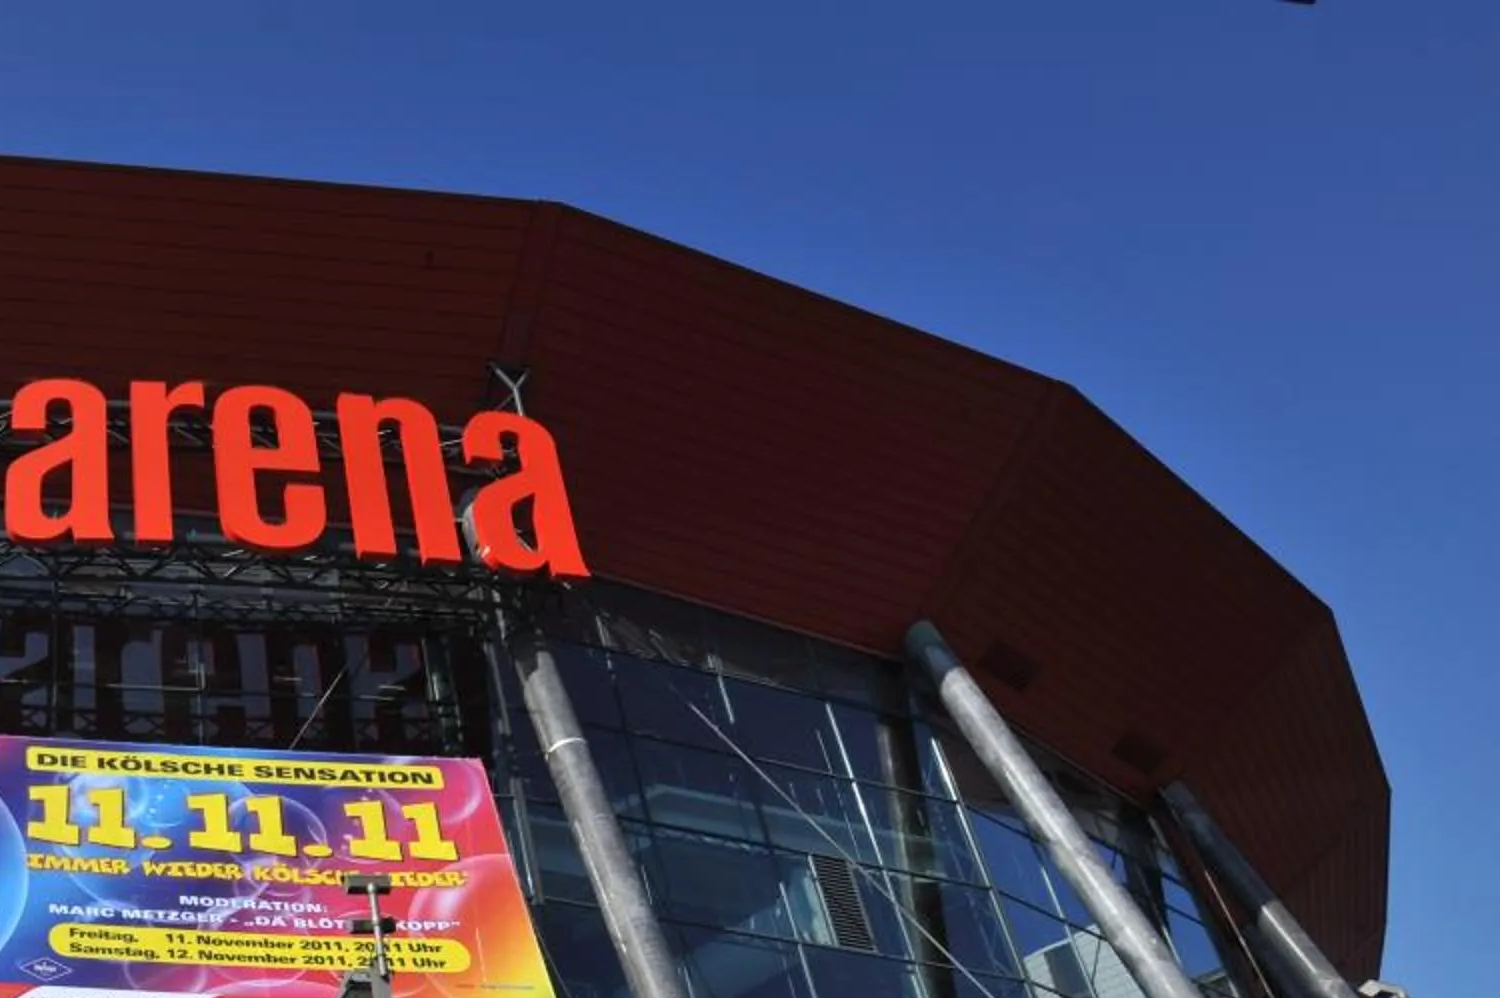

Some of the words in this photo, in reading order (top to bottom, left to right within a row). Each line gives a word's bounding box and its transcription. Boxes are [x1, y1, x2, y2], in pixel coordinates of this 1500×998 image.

[4, 378, 592, 578] arena
[36, 753, 87, 768] DIE
[97, 755, 245, 777] KÖLSCHE
[253, 765, 435, 785] SENSATION
[26, 853, 131, 875] IMMER
[142, 859, 245, 880] WIEDER
[253, 862, 360, 886] KÖLSC
[376, 871, 467, 888] IEDER
[49, 903, 116, 919] MARC
[121, 908, 224, 924] METZGER
[179, 895, 328, 914] MODERATION:
[165, 933, 193, 945] 11.
[196, 934, 295, 950] November
[353, 941, 403, 953] 201
[408, 943, 443, 954] Uhr
[167, 948, 193, 960] 12.
[197, 949, 299, 965] November
[356, 955, 407, 969] 211
[411, 956, 448, 969] Uhr
